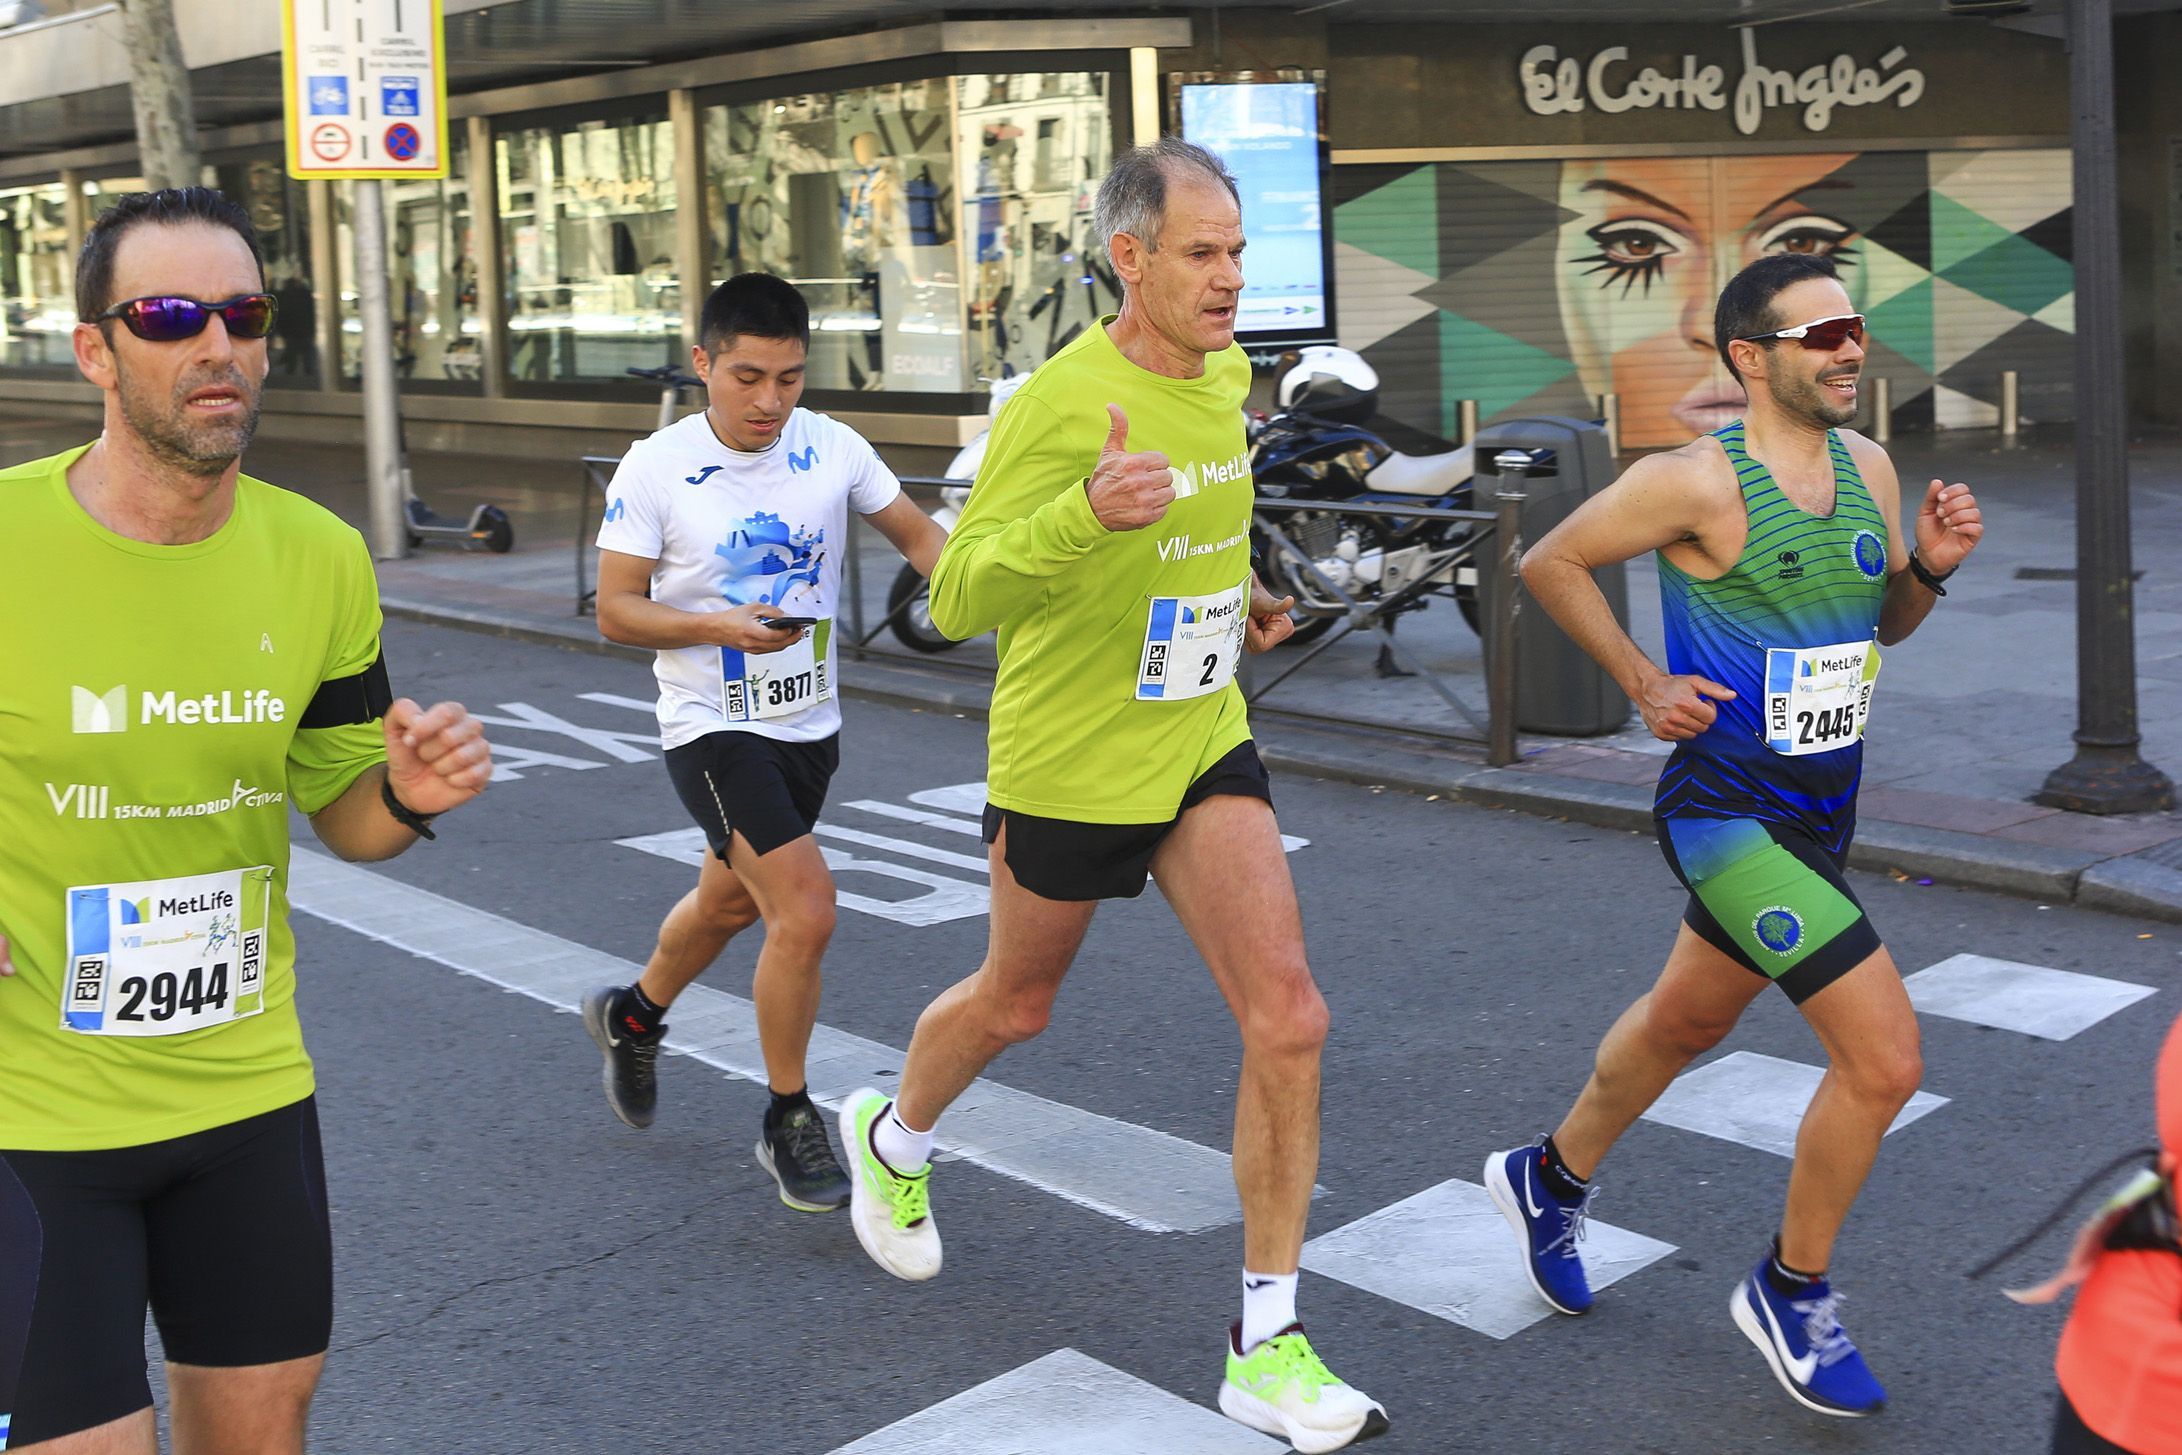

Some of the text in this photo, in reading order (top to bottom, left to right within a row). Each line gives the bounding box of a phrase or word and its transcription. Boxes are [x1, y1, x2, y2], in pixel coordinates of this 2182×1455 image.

[1520, 27, 1925, 135] El Corte Inglés
[1157, 534, 1190, 562] VIII
[1190, 543, 1214, 557] 15KM
[1206, 597, 1242, 620] MetLife
[1199, 653, 1218, 687] 2
[1821, 655, 1862, 673] MetLife
[768, 671, 812, 706] 3877
[141, 689, 285, 725] MetLife
[1796, 703, 1855, 745] 2445
[44, 782, 109, 819] VIII
[113, 805, 161, 820] 15KM
[166, 797, 231, 818] MADRID
[158, 890, 234, 918] MetLife
[116, 962, 229, 1022] 2944
